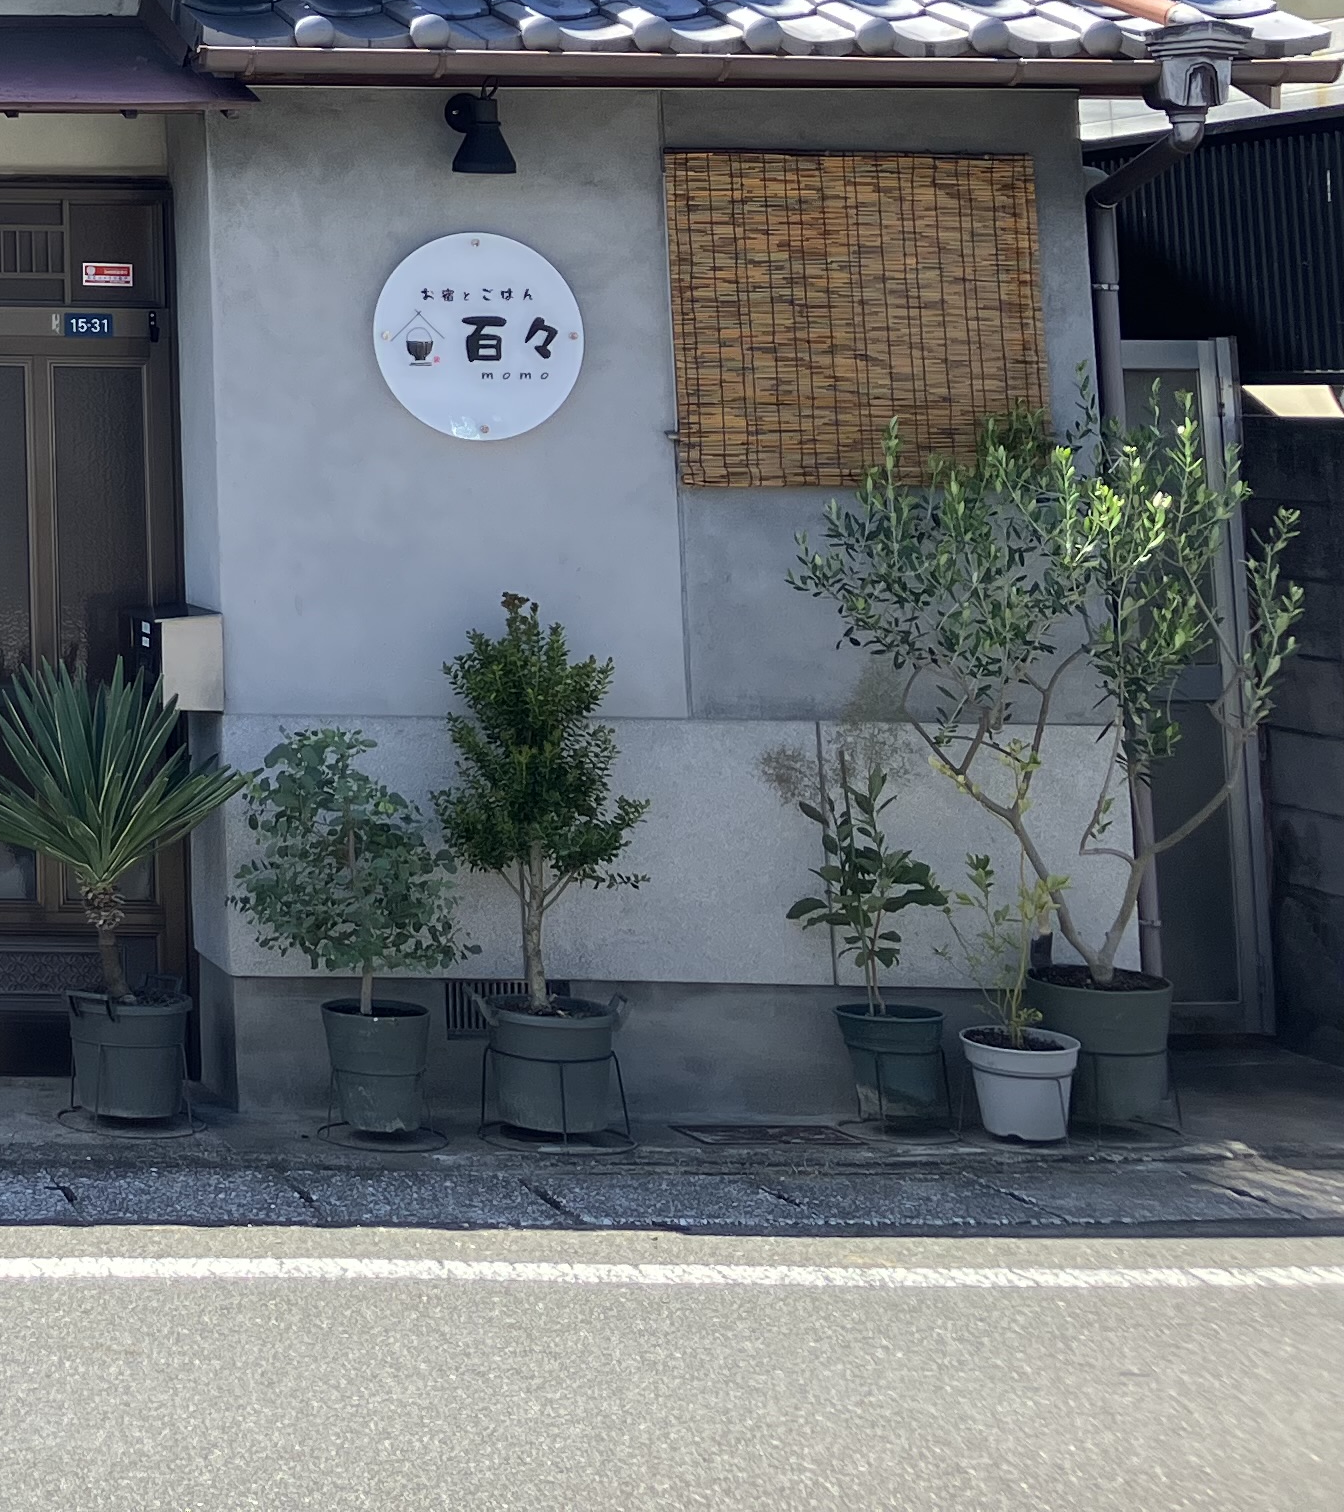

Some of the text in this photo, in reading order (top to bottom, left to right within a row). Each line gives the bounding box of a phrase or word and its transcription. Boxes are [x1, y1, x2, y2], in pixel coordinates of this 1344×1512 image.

[420, 287, 533, 302] お宿とごはん
[461, 315, 559, 363] 百々
[481, 371, 549, 380] momo
